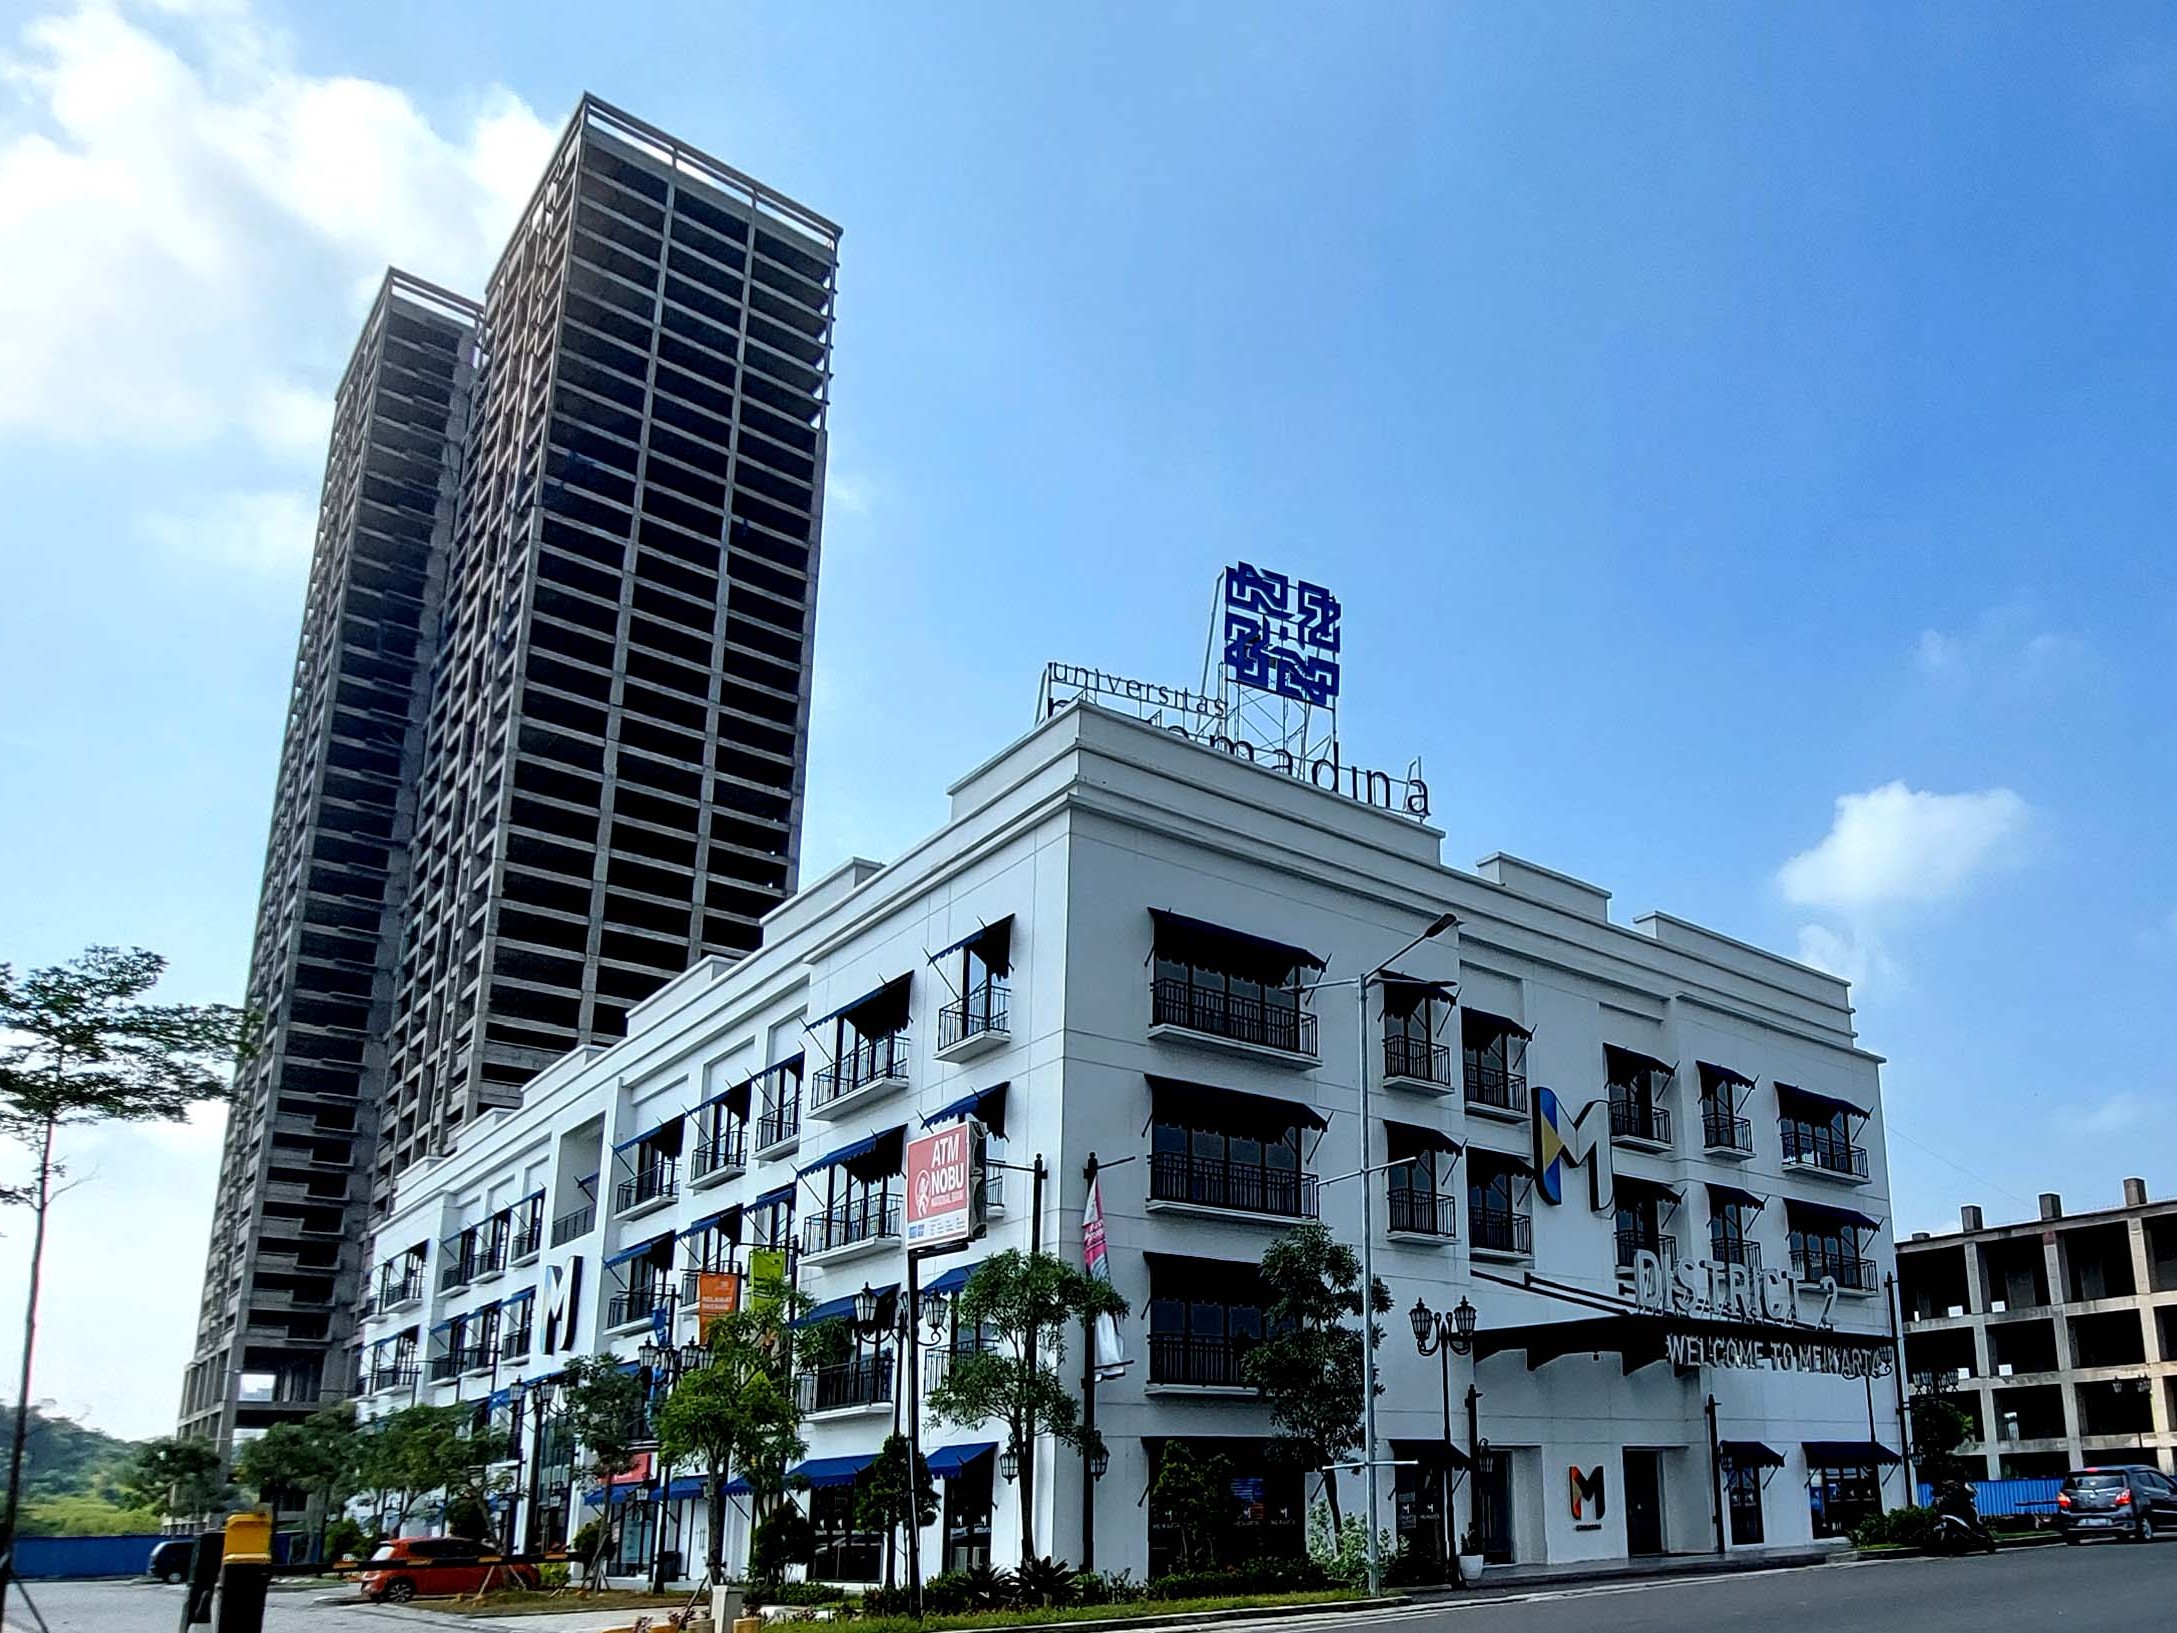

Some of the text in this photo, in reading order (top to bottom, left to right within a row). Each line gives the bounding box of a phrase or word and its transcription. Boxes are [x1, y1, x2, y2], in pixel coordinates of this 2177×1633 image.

[931, 1133, 960, 1169] ATM
[931, 1162, 965, 1197] NOBU
[1634, 1248, 1838, 1329] DISTRICT 2
[1666, 1334, 1886, 1377] WELCOME TO MEIKARTA
